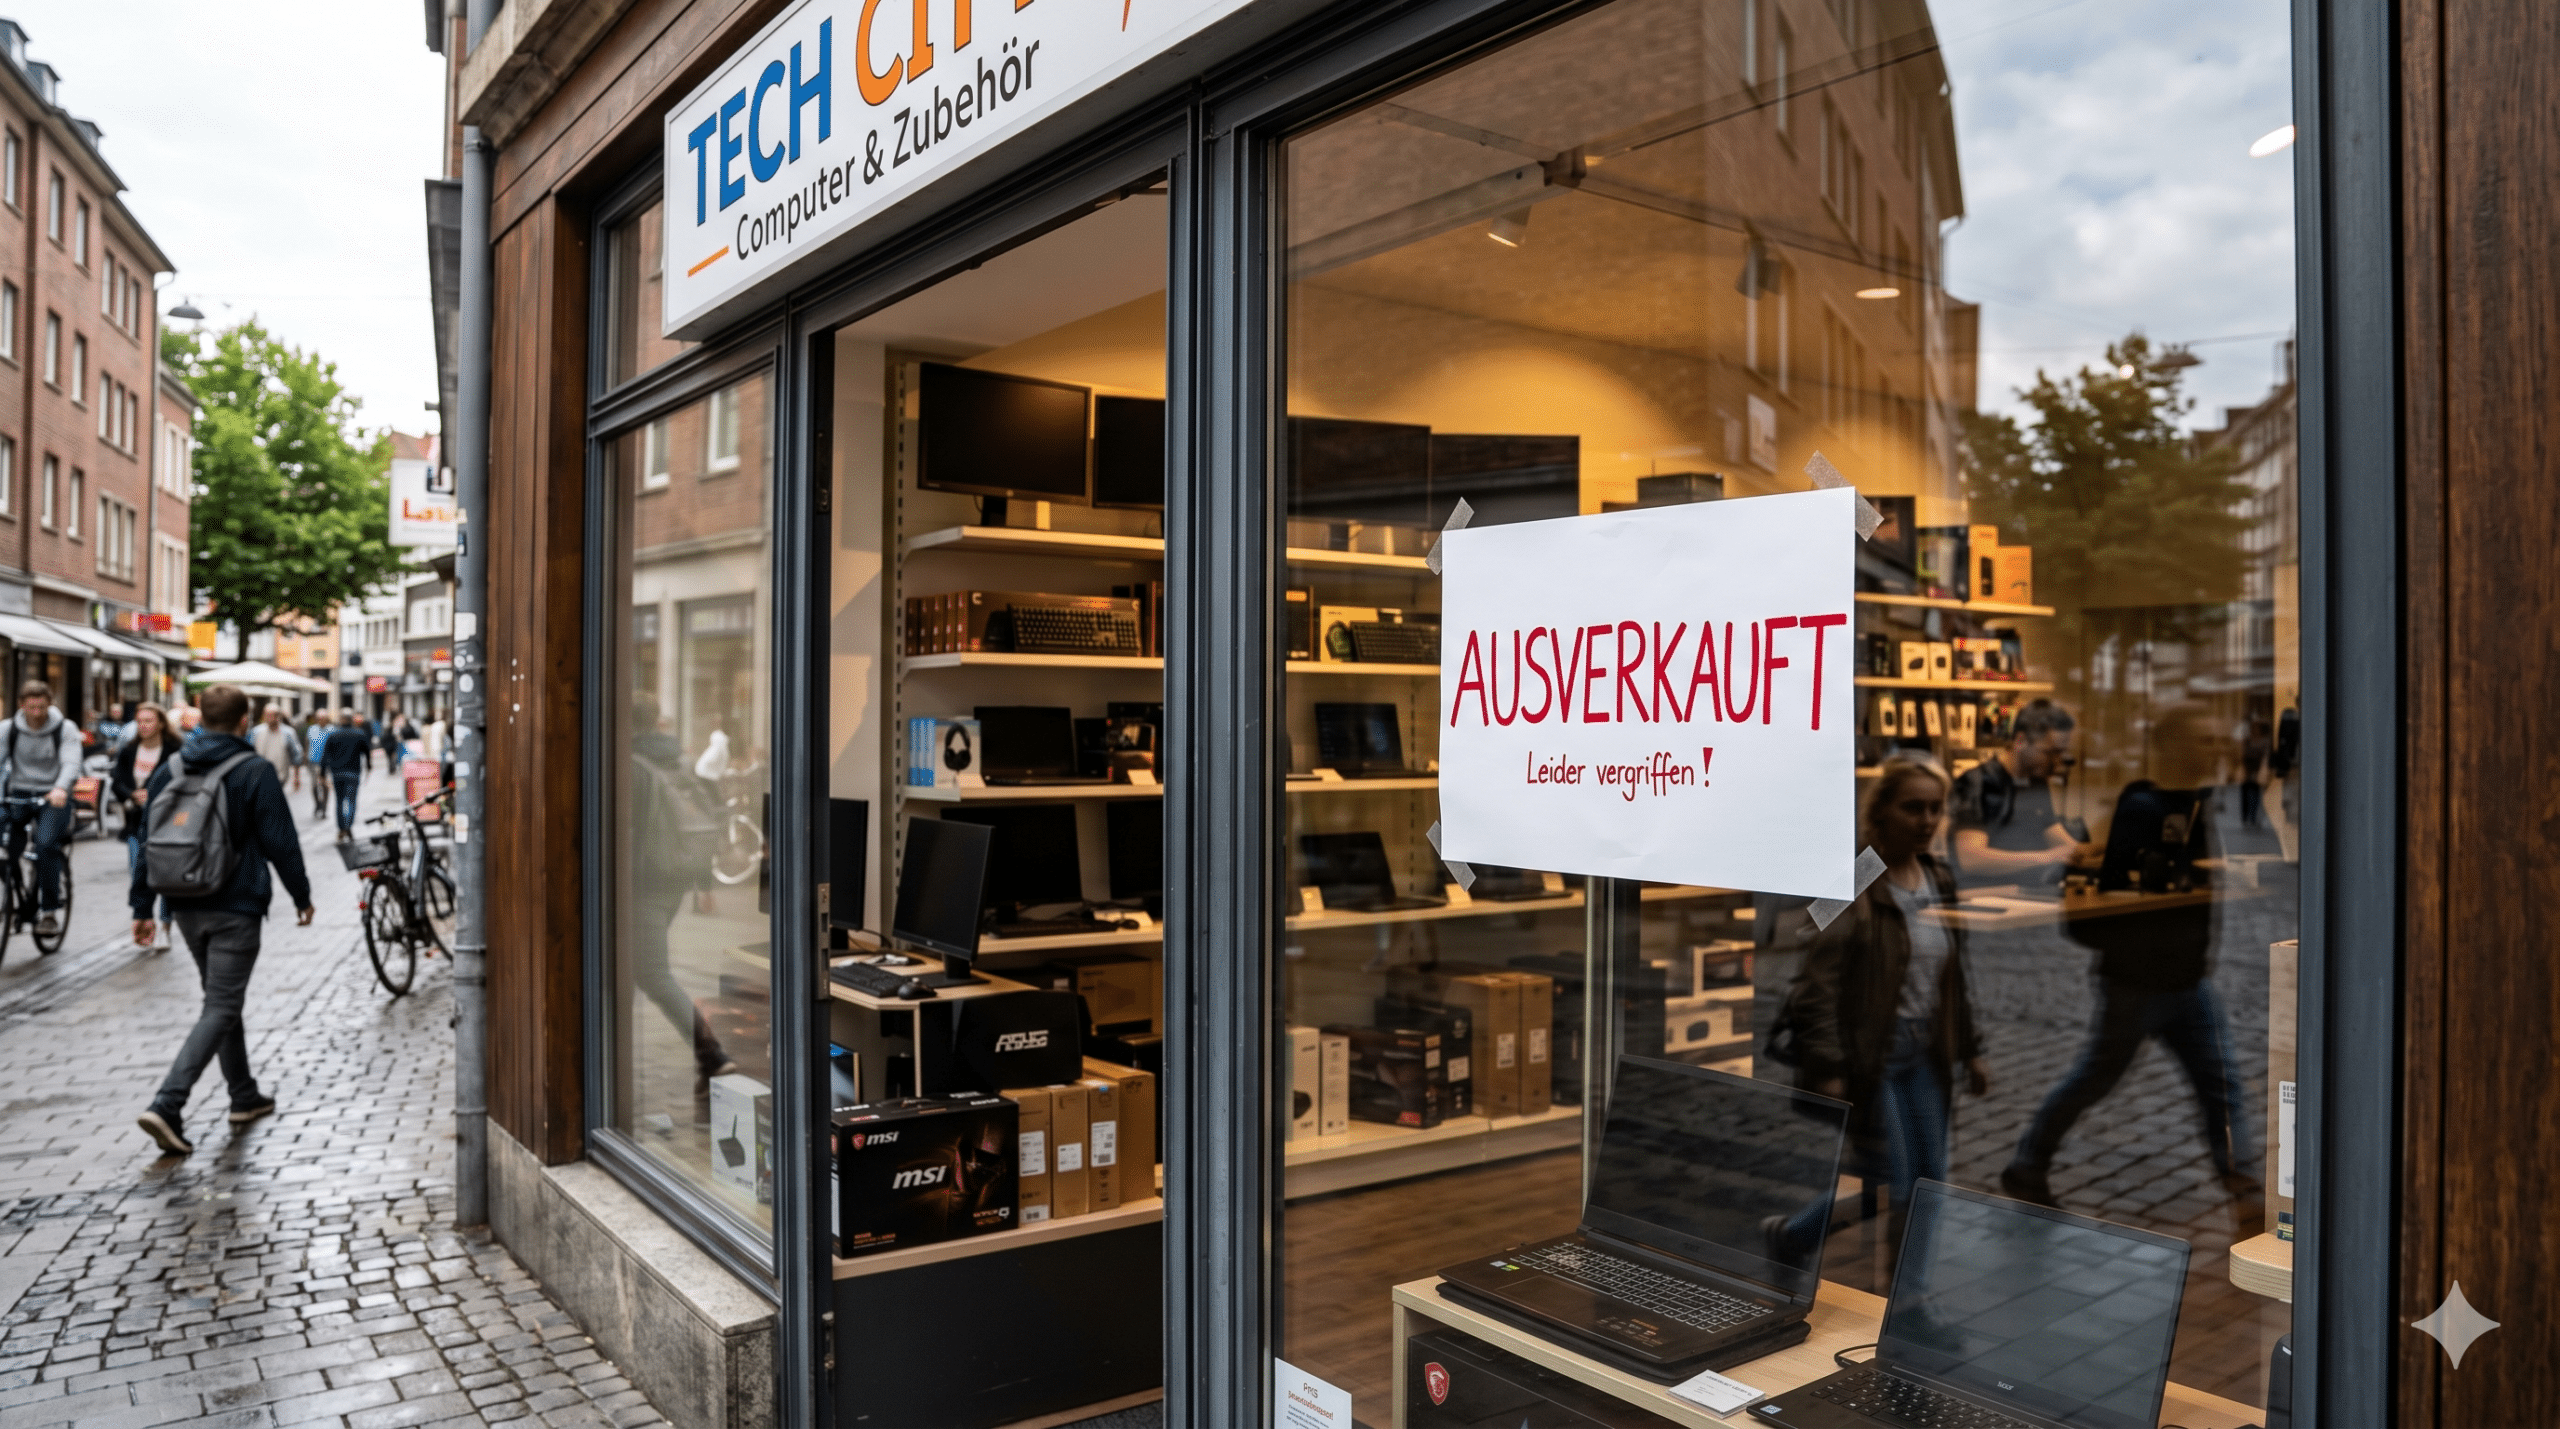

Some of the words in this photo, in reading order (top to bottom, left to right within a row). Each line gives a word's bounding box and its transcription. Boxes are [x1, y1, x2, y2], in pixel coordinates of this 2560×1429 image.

[688, 17, 832, 226] TECH
[855, 0, 1033, 106] CI
[736, 156, 855, 261] Computer
[863, 129, 885, 185] &
[893, 37, 1040, 169] Zubehör
[1450, 613, 1848, 731] AUSVERKAUFT
[1527, 751, 1586, 785] Leider
[866, 1131, 900, 1146] msi
[892, 1164, 948, 1190] msi
